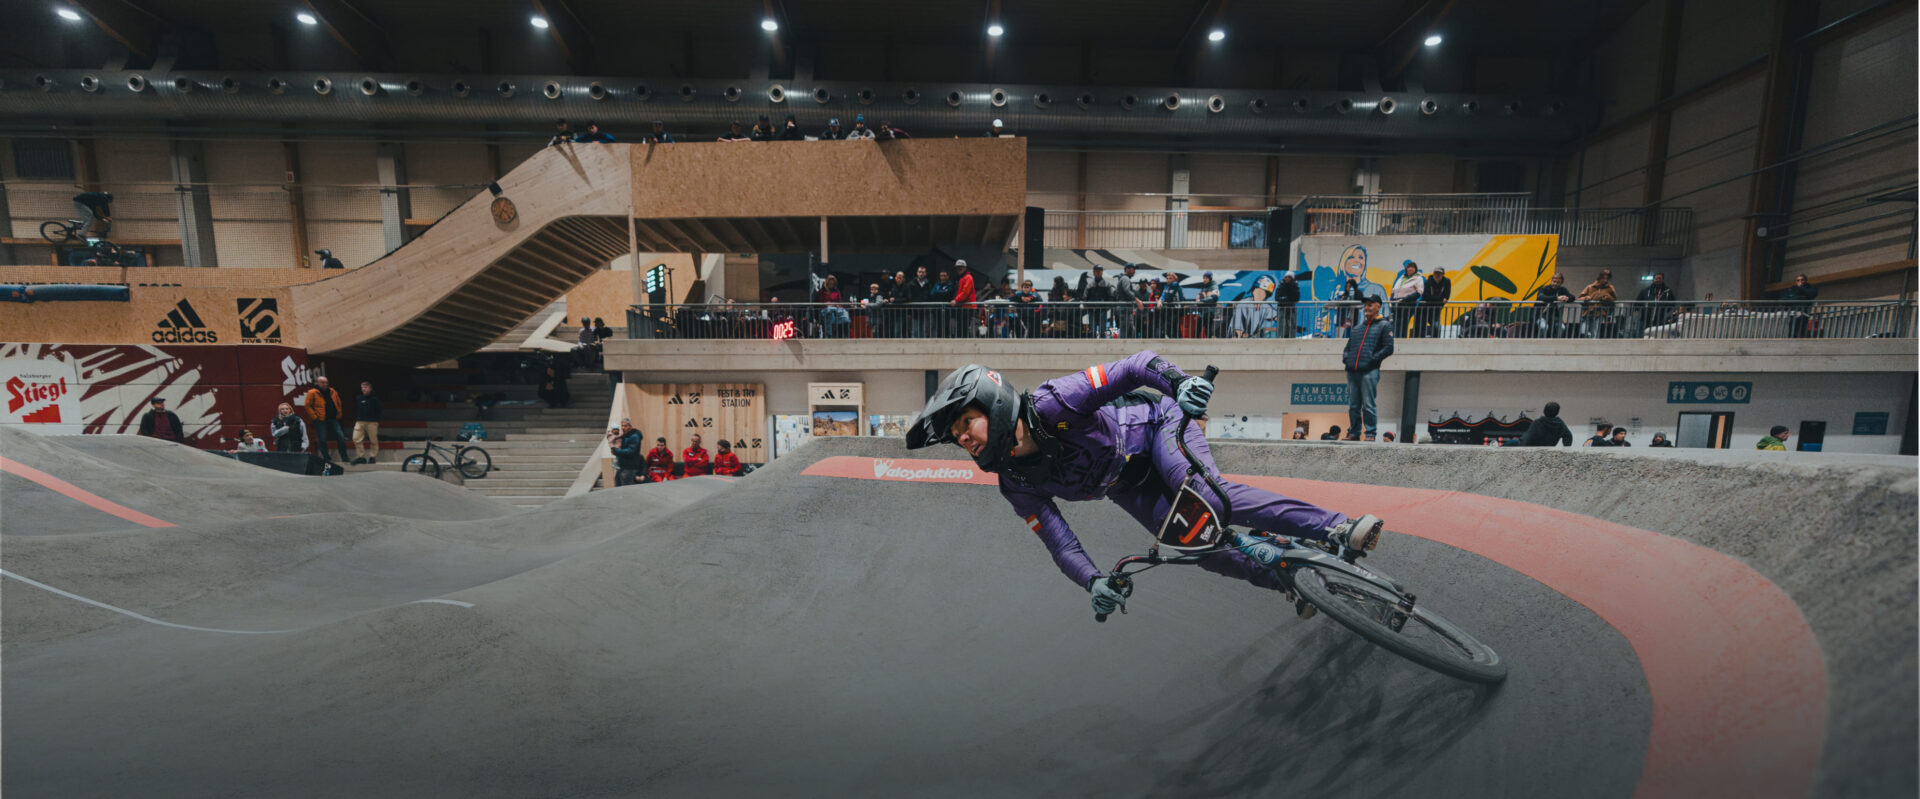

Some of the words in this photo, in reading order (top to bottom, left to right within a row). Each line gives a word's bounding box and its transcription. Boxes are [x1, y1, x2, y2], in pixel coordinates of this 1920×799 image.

[152, 327, 218, 343] adidas
[6, 376, 67, 414] Stiegl
[717, 388, 734, 398] TEST
[742, 388, 756, 398] TRY
[721, 399, 751, 407] STATION
[1172, 512, 1189, 528] 7
